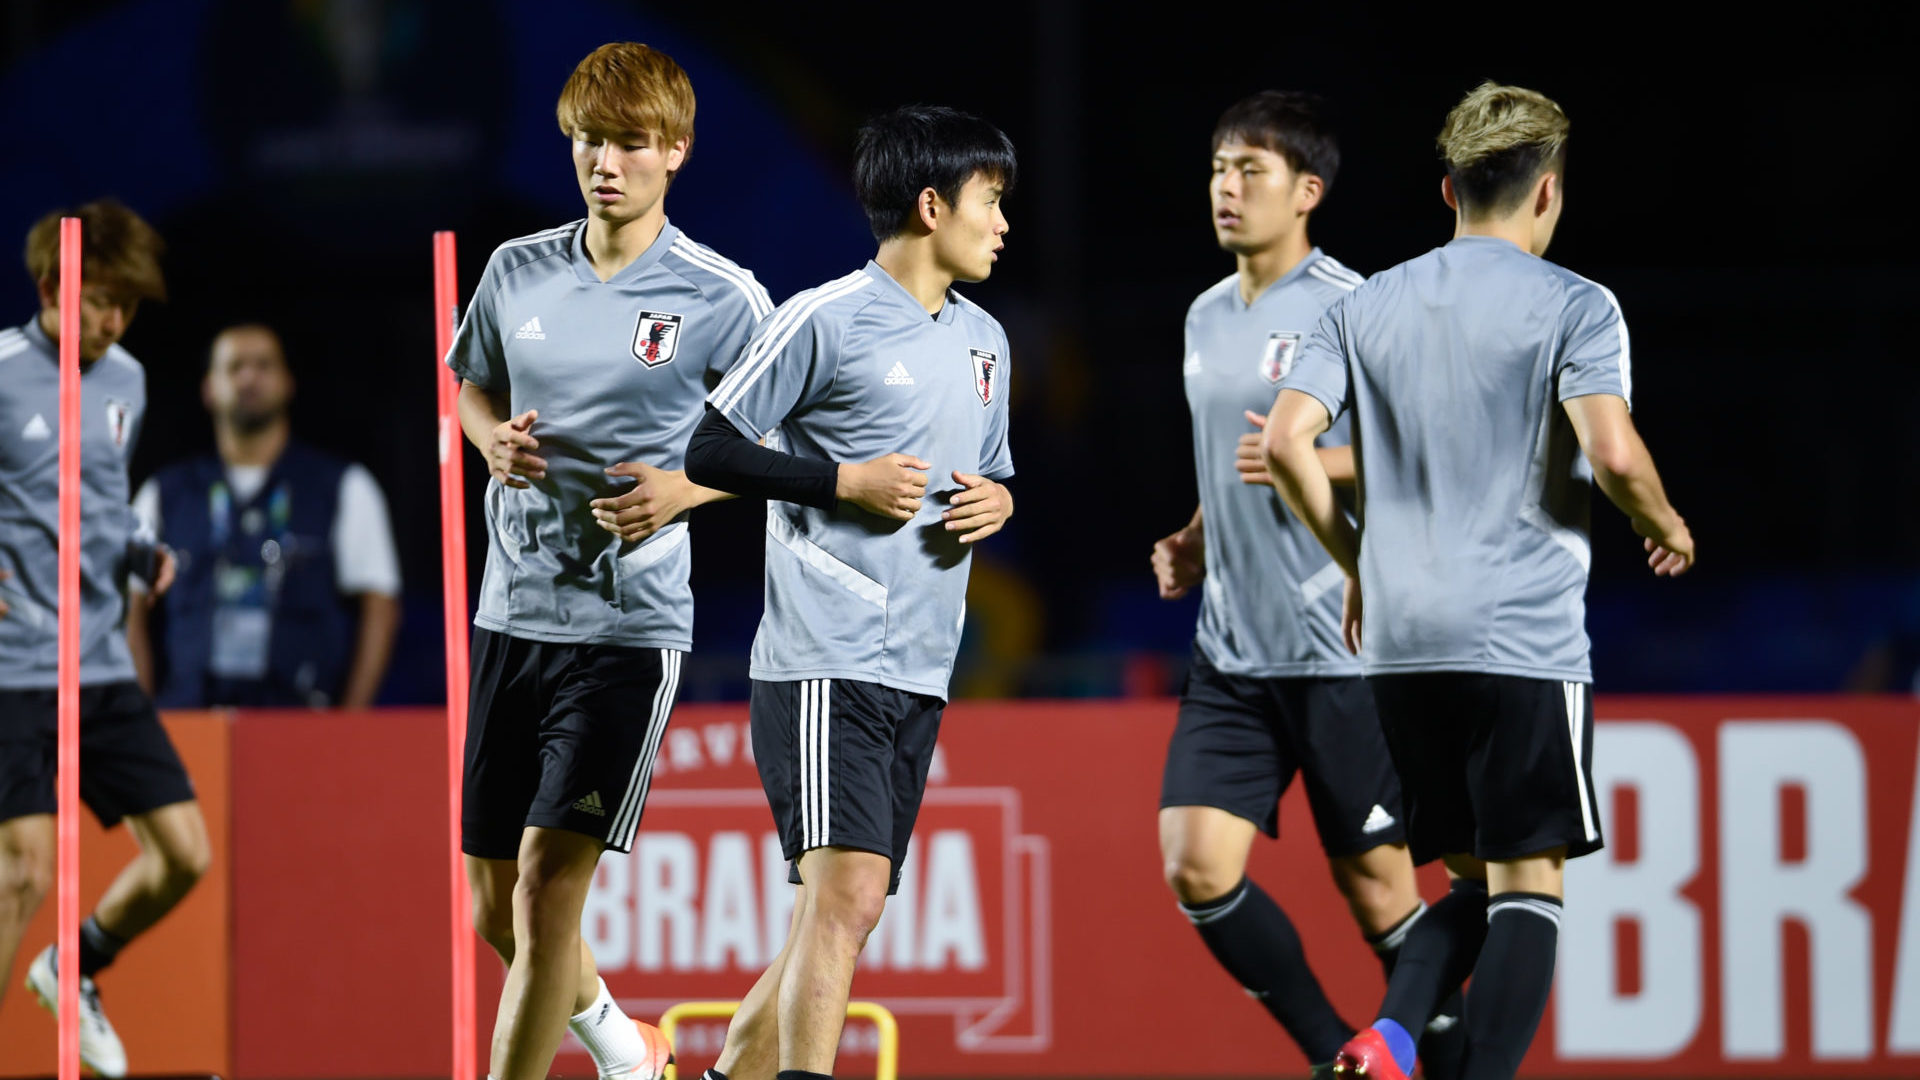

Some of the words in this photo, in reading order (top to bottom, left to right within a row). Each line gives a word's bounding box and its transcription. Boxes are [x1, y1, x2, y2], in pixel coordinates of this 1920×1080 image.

[515, 331, 546, 340] adidas
[884, 376, 914, 386] adidas
[572, 802, 606, 817] adidas
[1554, 720, 1920, 1062] BR
